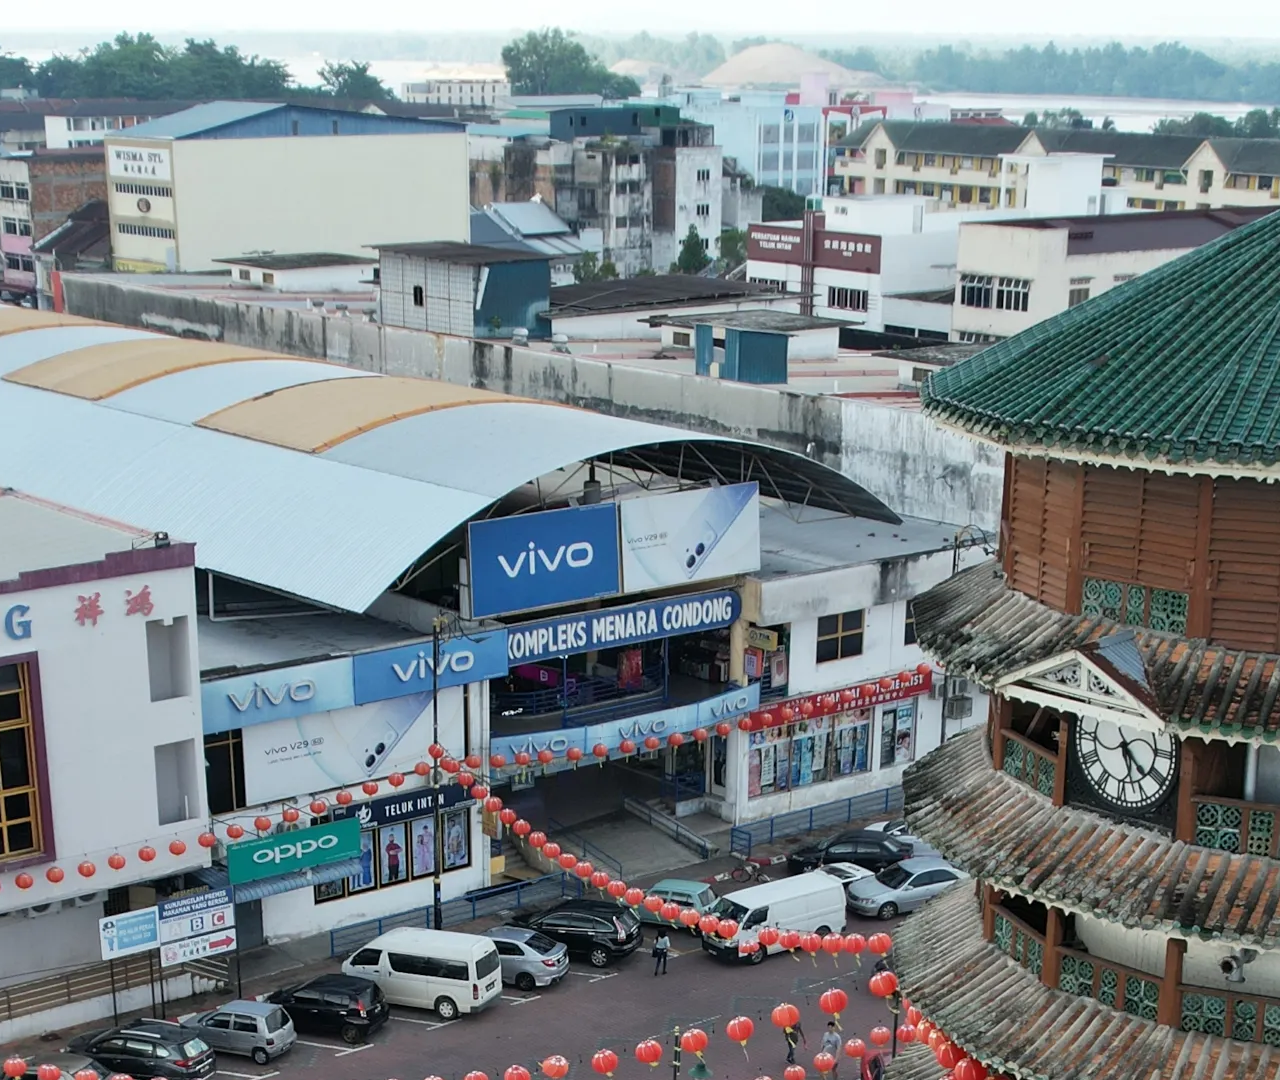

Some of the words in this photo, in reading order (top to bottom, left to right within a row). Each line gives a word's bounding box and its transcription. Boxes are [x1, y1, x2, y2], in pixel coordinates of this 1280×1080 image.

[114, 149, 144, 162] WISMA
[497, 541, 594, 579] vivo
[592, 608, 658, 644] MENARA
[662, 596, 733, 630] CONDONG
[392, 650, 475, 683] vivo
[227, 679, 317, 713] vivo
[710, 696, 750, 718] vivo
[618, 718, 668, 740] vivo
[264, 745, 288, 756] vivo
[289, 739, 310, 751] V29
[509, 735, 570, 756] vivo
[384, 801, 414, 818] TELUK
[417, 792, 445, 812] INTN
[252, 834, 339, 864] oppo
[192, 918, 204, 931] B
[213, 912, 225, 925] C
